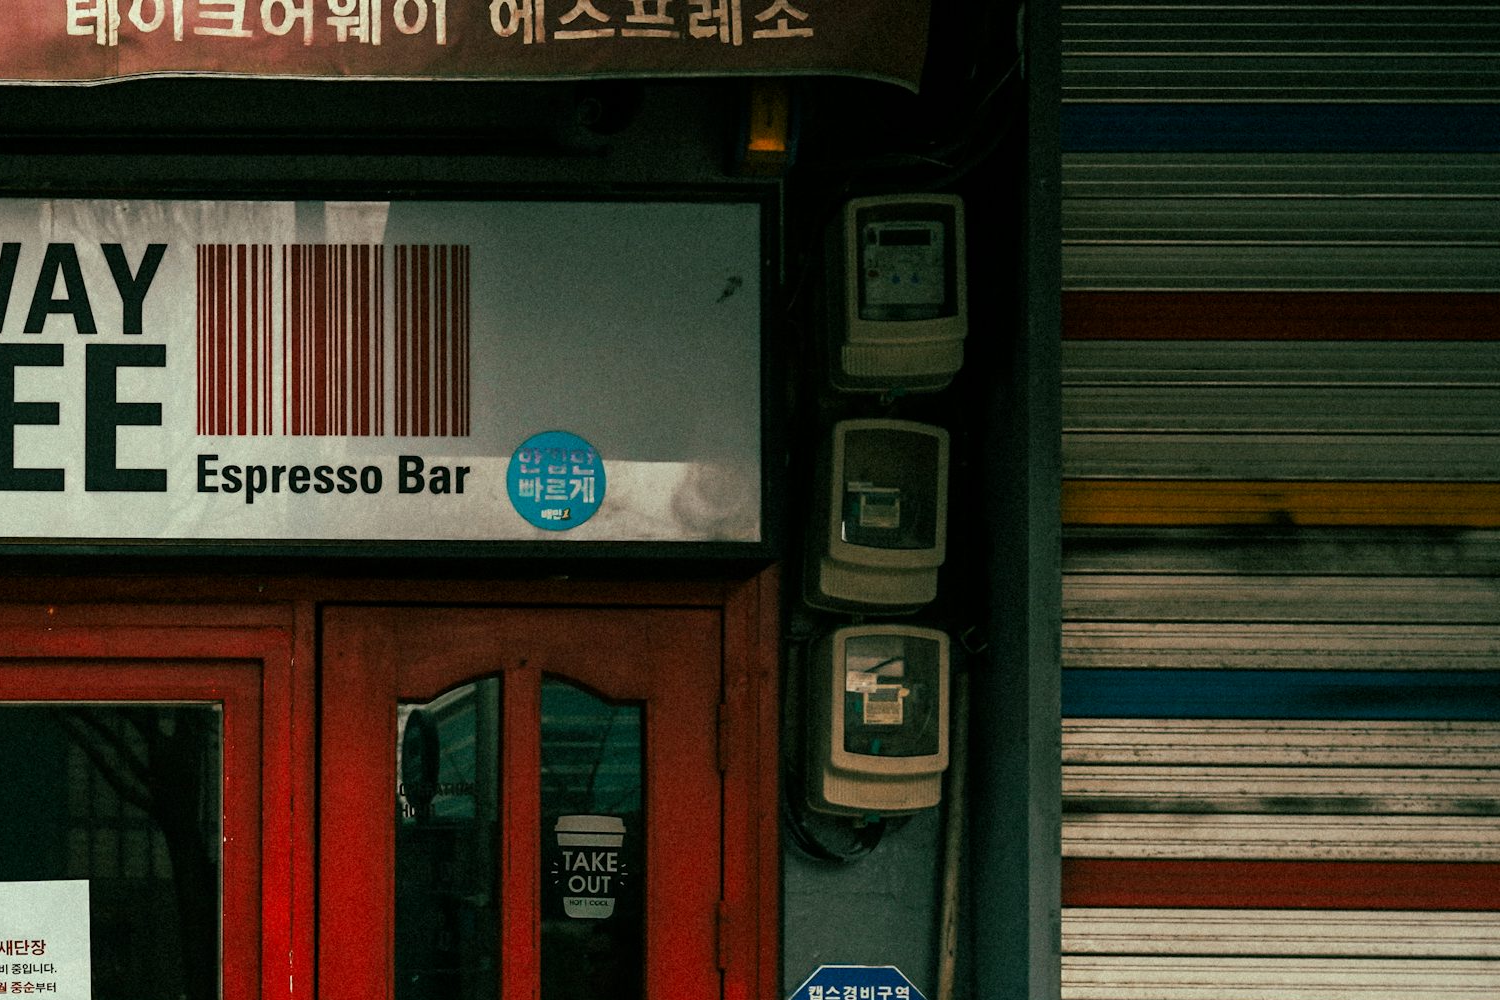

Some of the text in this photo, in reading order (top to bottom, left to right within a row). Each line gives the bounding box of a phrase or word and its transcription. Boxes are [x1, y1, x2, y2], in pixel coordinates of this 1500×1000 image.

[66, 0, 814, 46] 테이크어웨이 에스프레소
[196, 454, 471, 504] Espresso Bar
[518, 476, 595, 503] 빠르게
[562, 851, 618, 872] TAKE
[568, 875, 612, 893] OUT
[11, 963, 57, 975] 중입니다.
[10, 981, 57, 994] 중순부터
